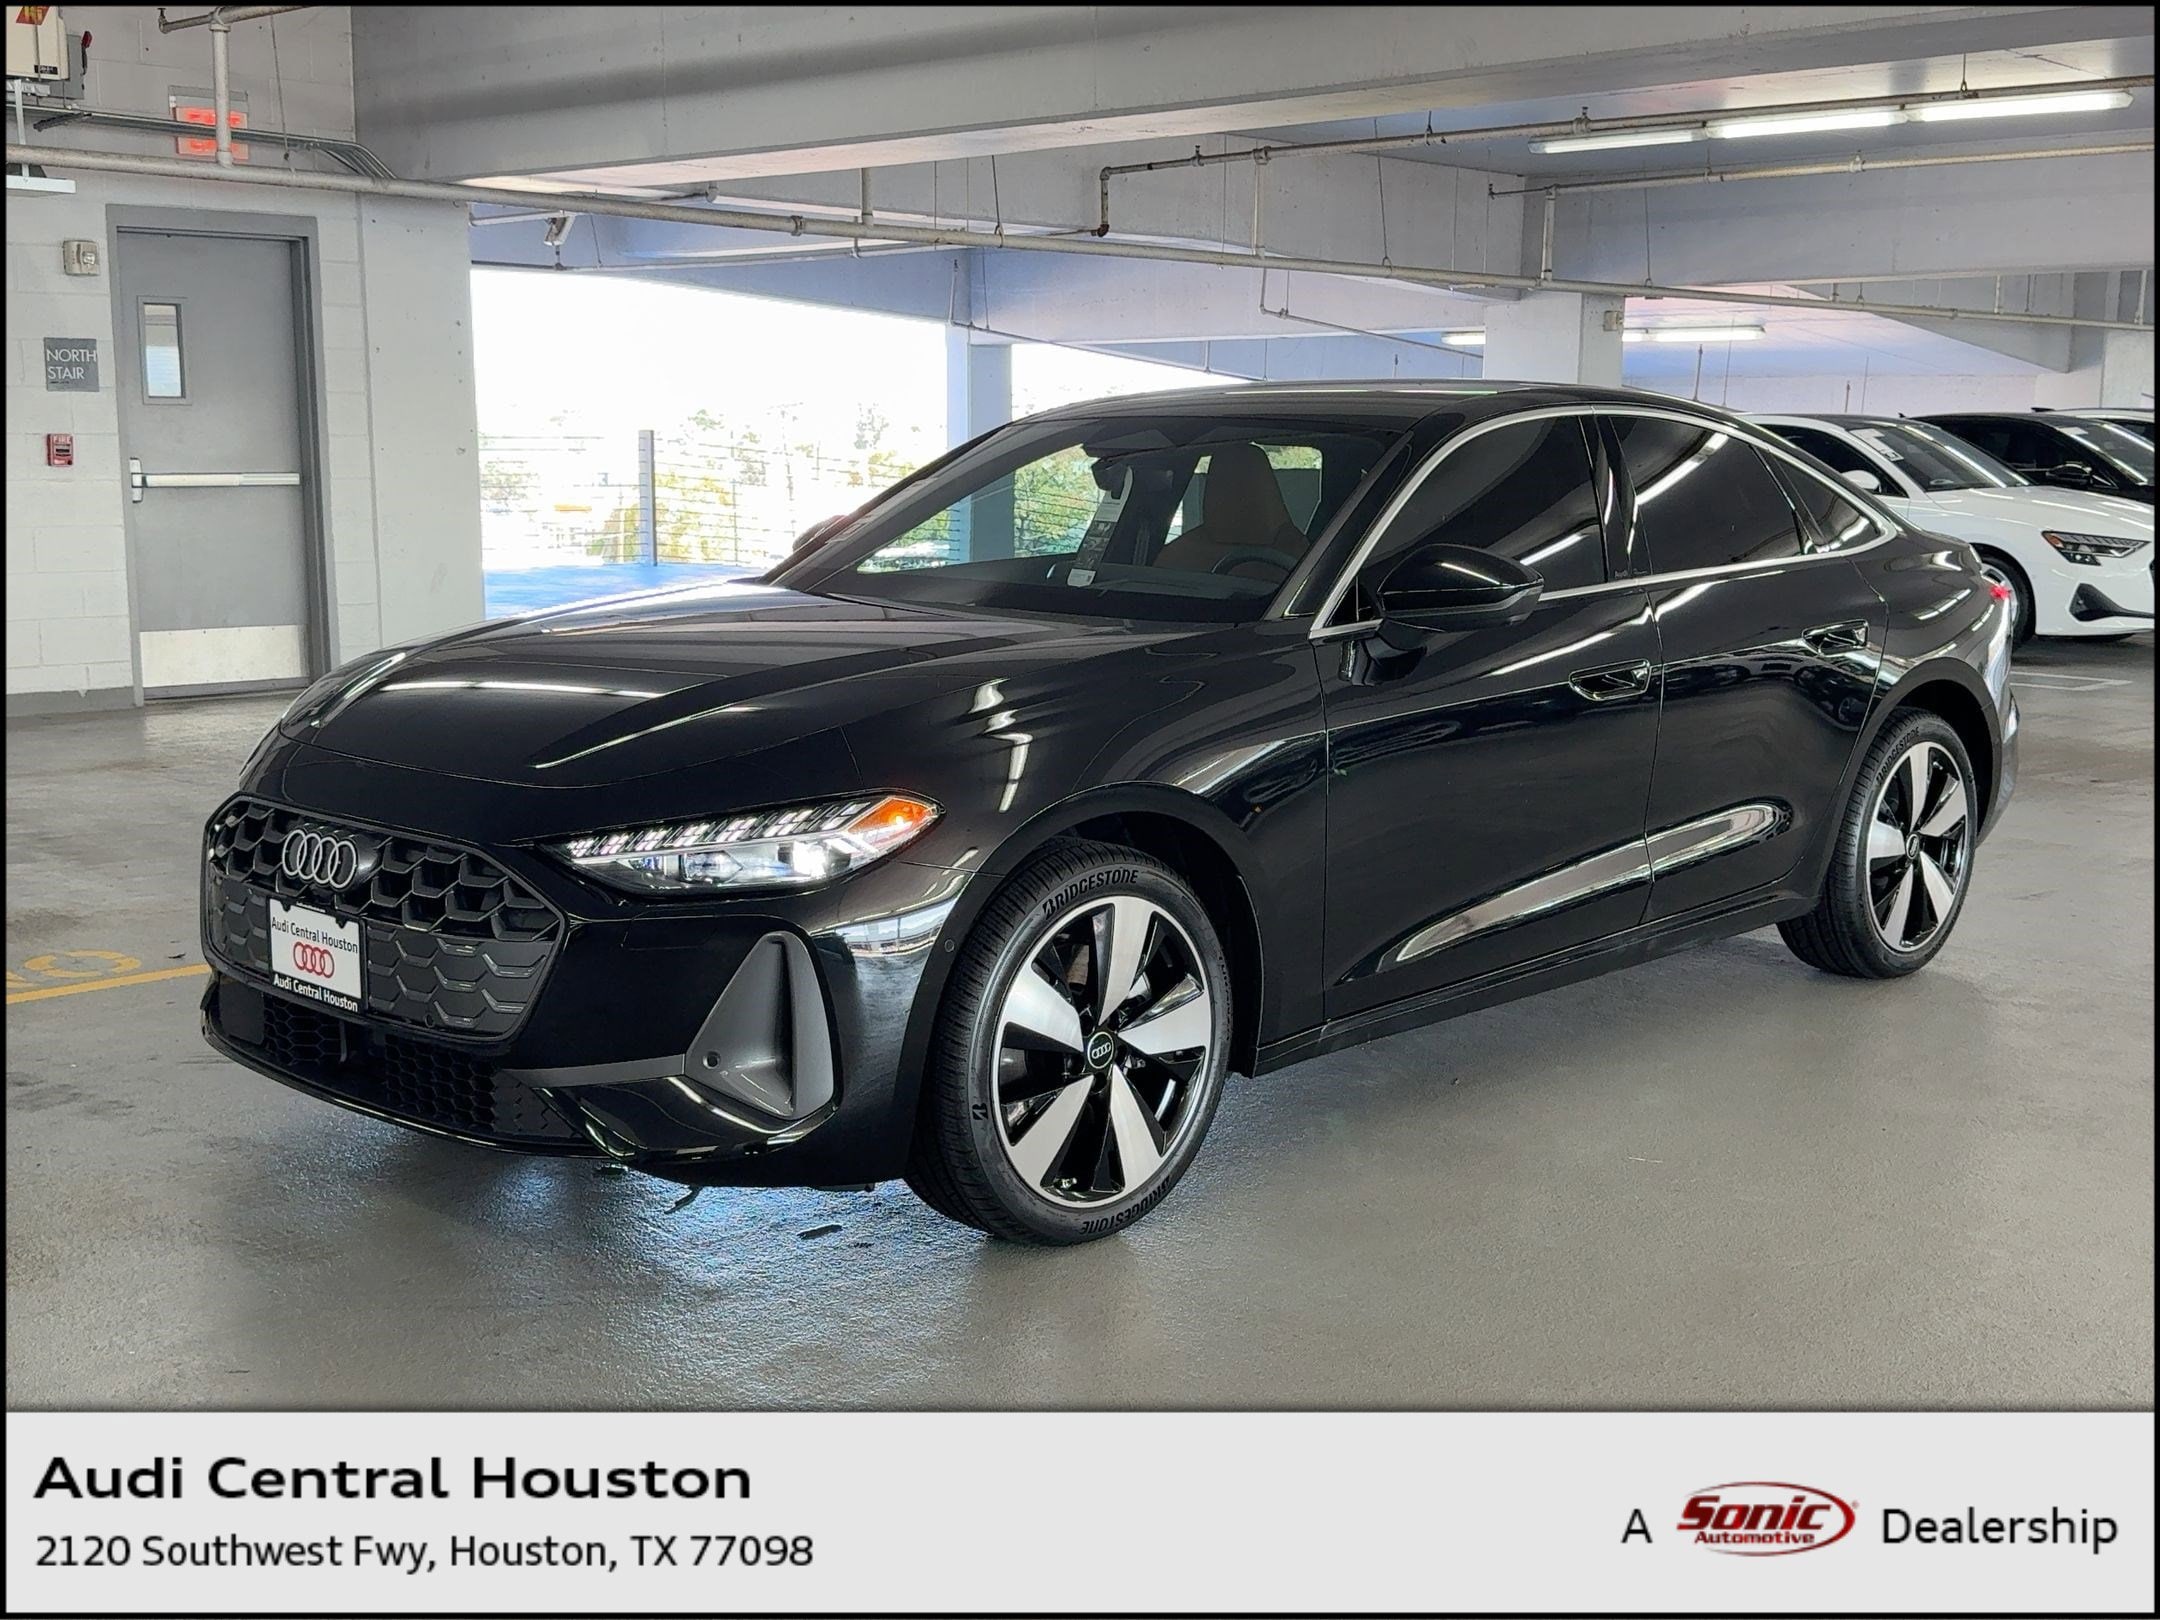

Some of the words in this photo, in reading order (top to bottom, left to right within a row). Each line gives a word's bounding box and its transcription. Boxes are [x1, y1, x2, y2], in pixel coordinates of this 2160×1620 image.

[46, 349, 97, 362] NORTH
[48, 366, 85, 380] STAIR
[1042, 867, 1139, 920] BRIDGESTONE
[271, 916, 290, 934] Audi
[290, 922, 320, 943] Central
[321, 931, 358, 954] Houston
[273, 973, 292, 990] Audi
[293, 979, 322, 1001] Central
[323, 989, 358, 1013] Houston
